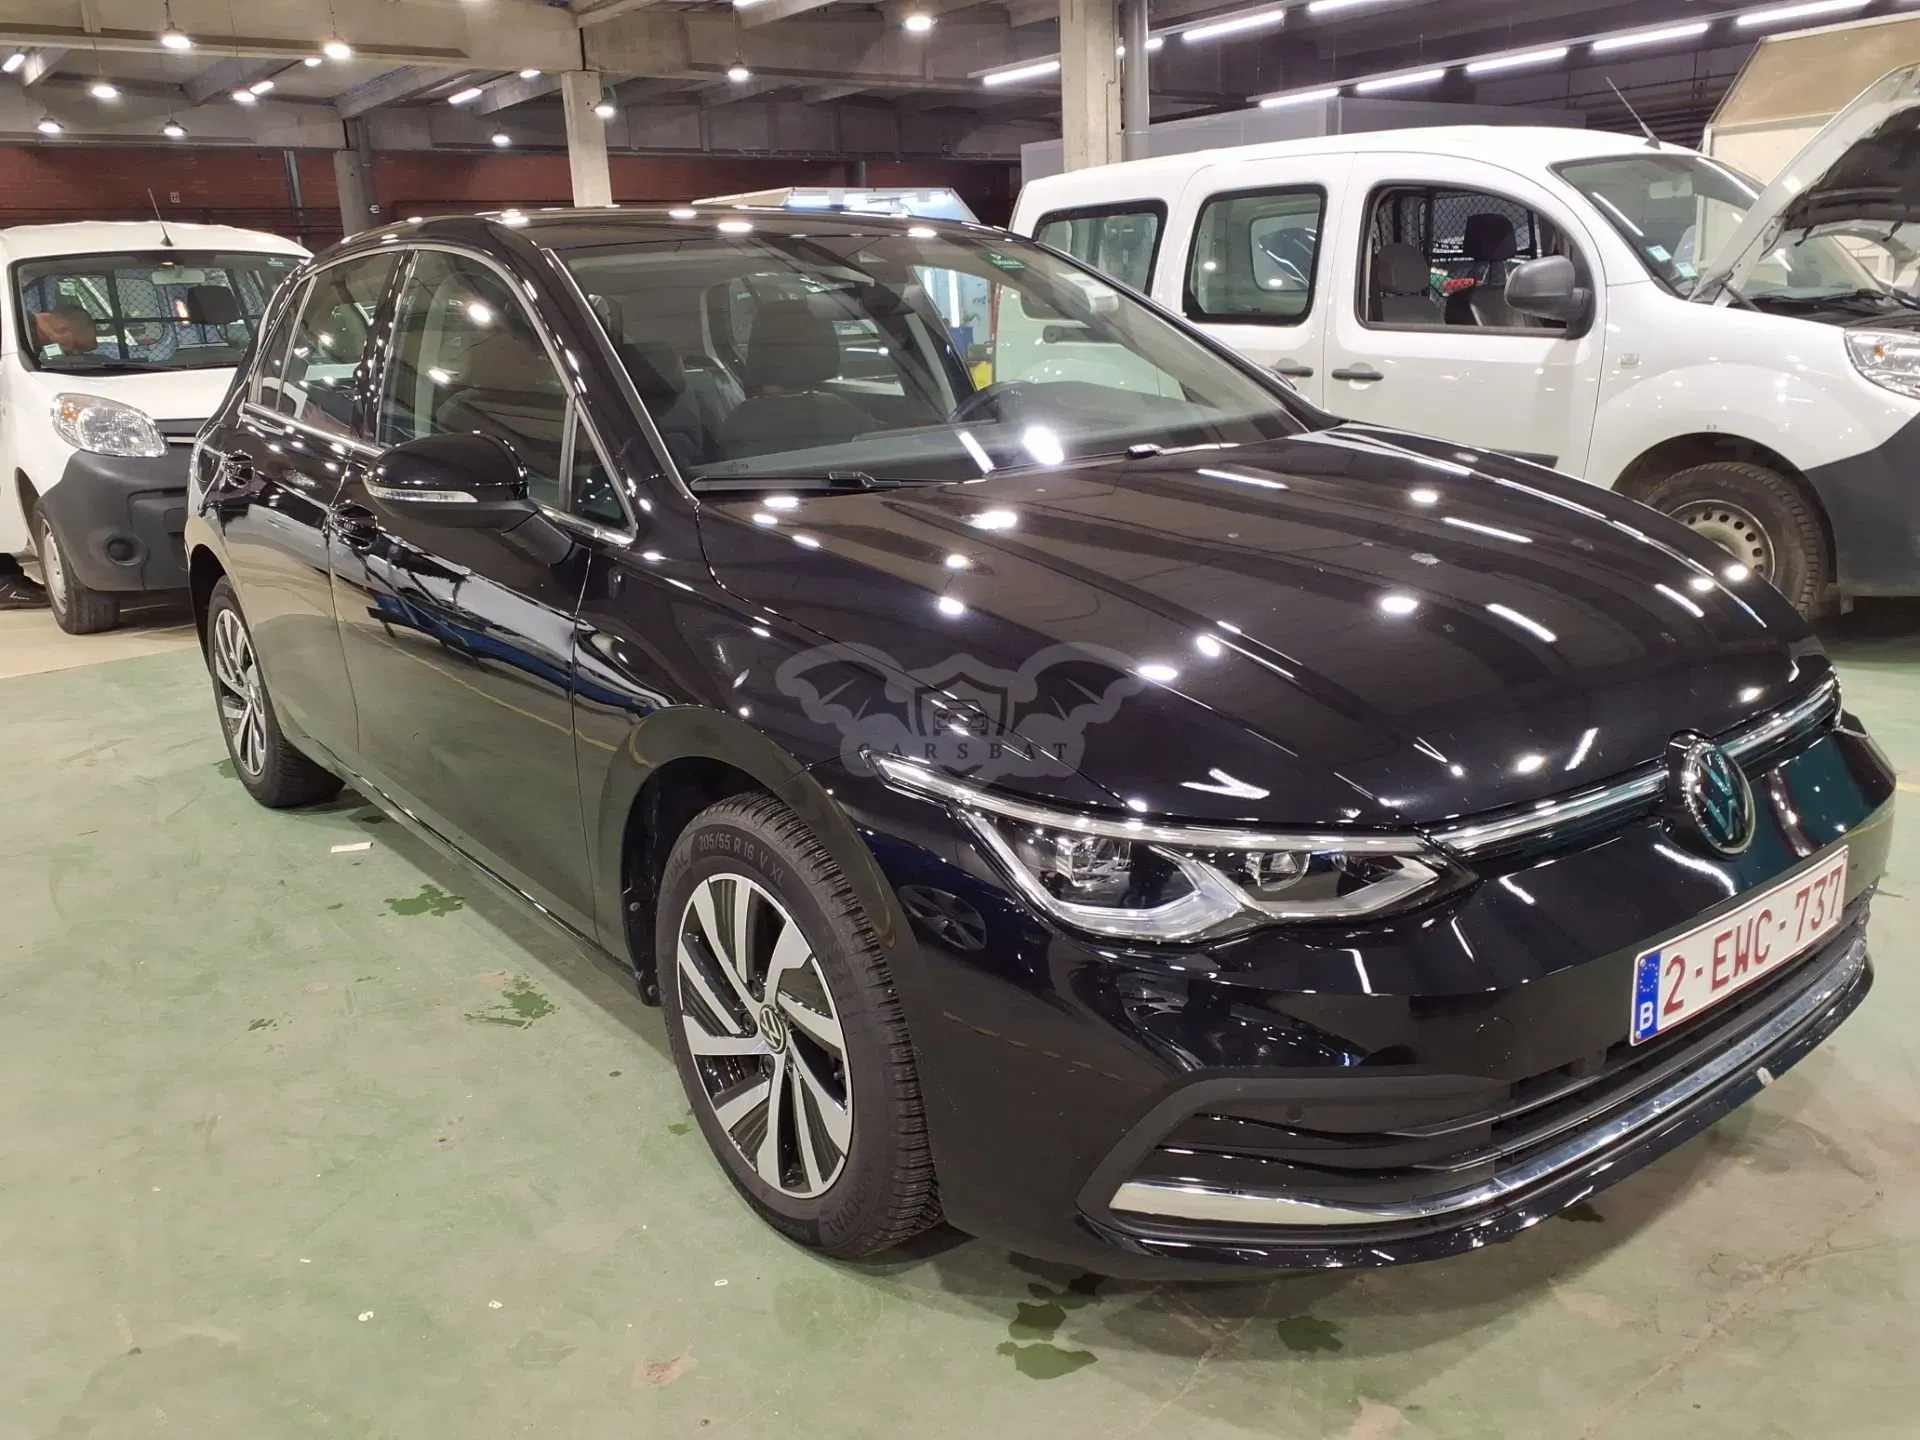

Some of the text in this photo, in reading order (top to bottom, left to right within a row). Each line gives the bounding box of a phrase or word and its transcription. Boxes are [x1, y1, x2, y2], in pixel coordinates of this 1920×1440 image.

[699, 832, 731, 851] 205/55
[734, 837, 741, 854] R
[743, 841, 755, 860] 16
[760, 851, 769, 869] V
[1663, 864, 1843, 1017] 2-EWC-737
[1640, 1001, 1654, 1031] B
